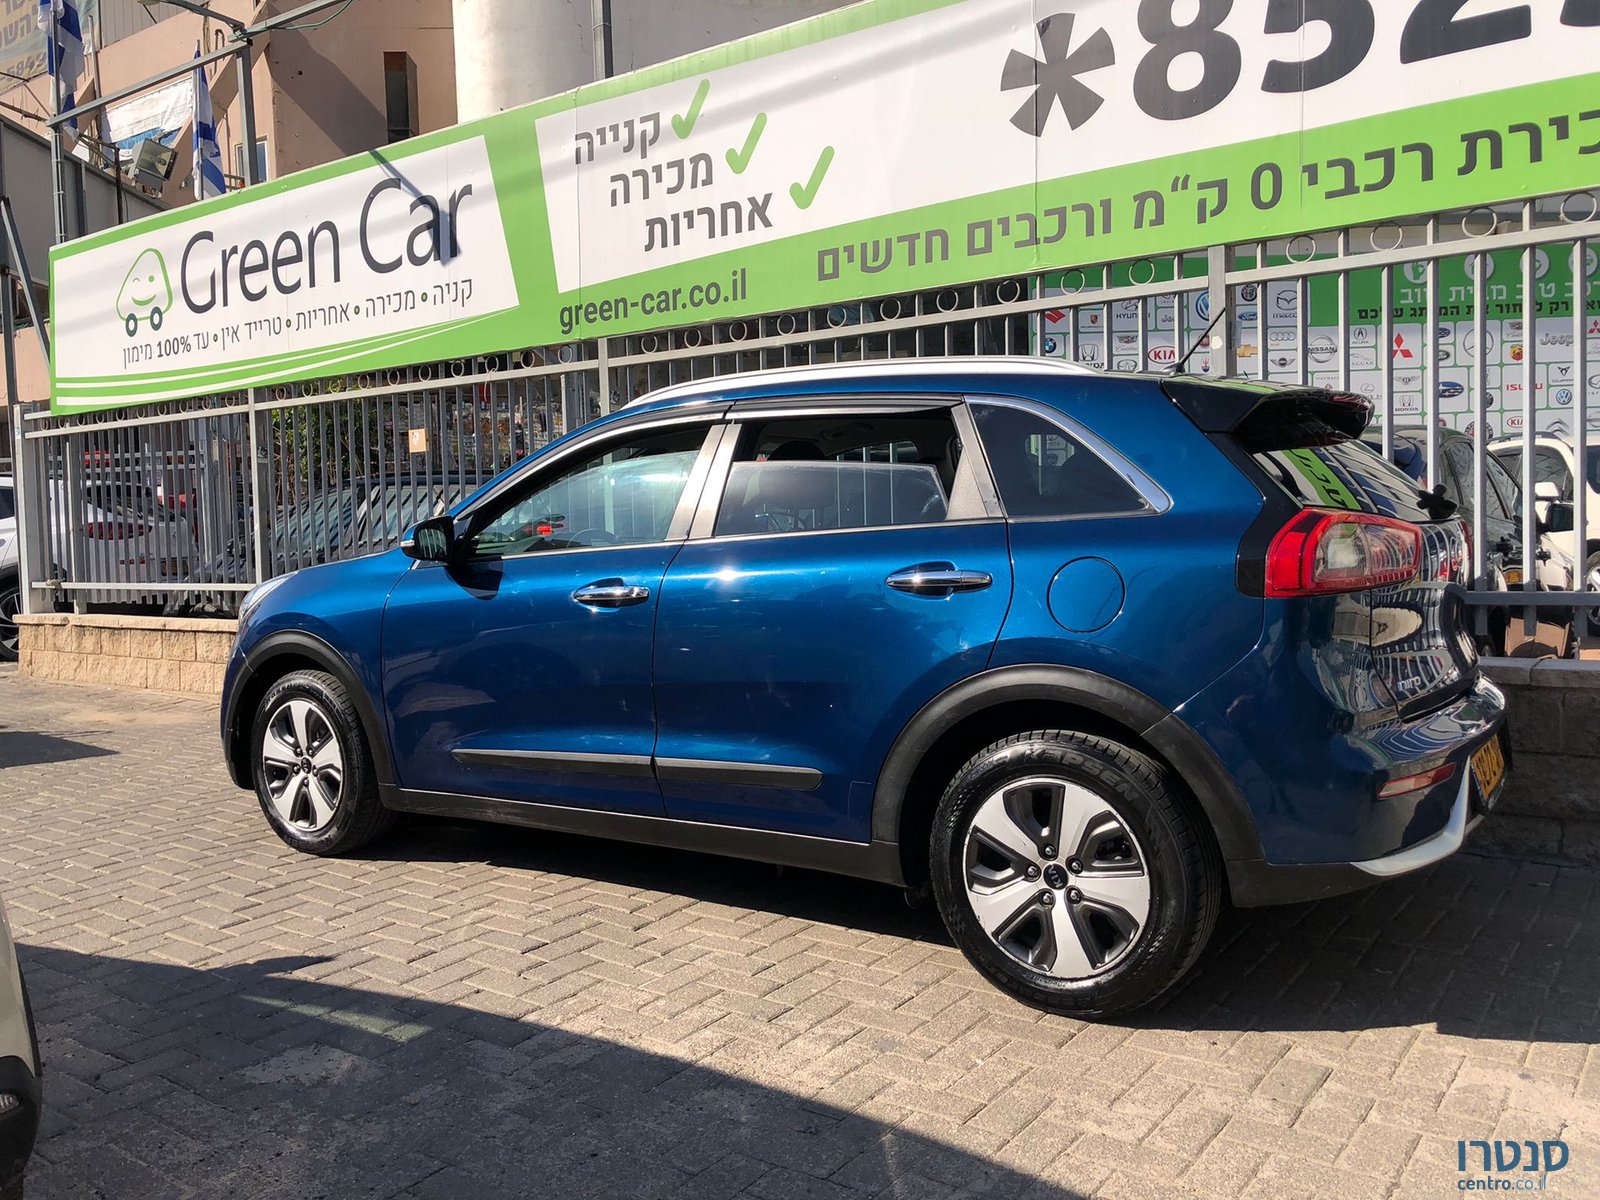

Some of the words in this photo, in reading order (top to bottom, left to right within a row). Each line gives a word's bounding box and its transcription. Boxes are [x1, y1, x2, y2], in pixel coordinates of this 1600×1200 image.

[574, 111, 661, 164] קנייה
[610, 152, 713, 207] מכירה
[1250, 162, 1283, 210] 0
[1301, 142, 1433, 200] רכבי
[181, 220, 341, 314] Green
[360, 177, 473, 274] Car
[644, 192, 773, 252] אחריות
[967, 198, 1112, 257] ורכבים
[817, 228, 949, 282] חדשים
[294, 302, 350, 331] אחריות
[366, 290, 416, 318] מכירה
[433, 278, 473, 308] קניה
[559, 268, 747, 335] green-car.co.il
[157, 335, 192, 358] 100%
[193, 331, 209, 351] עד
[221, 324, 240, 351] אין
[244, 316, 282, 340] טרייד
[122, 343, 153, 370] מימון
